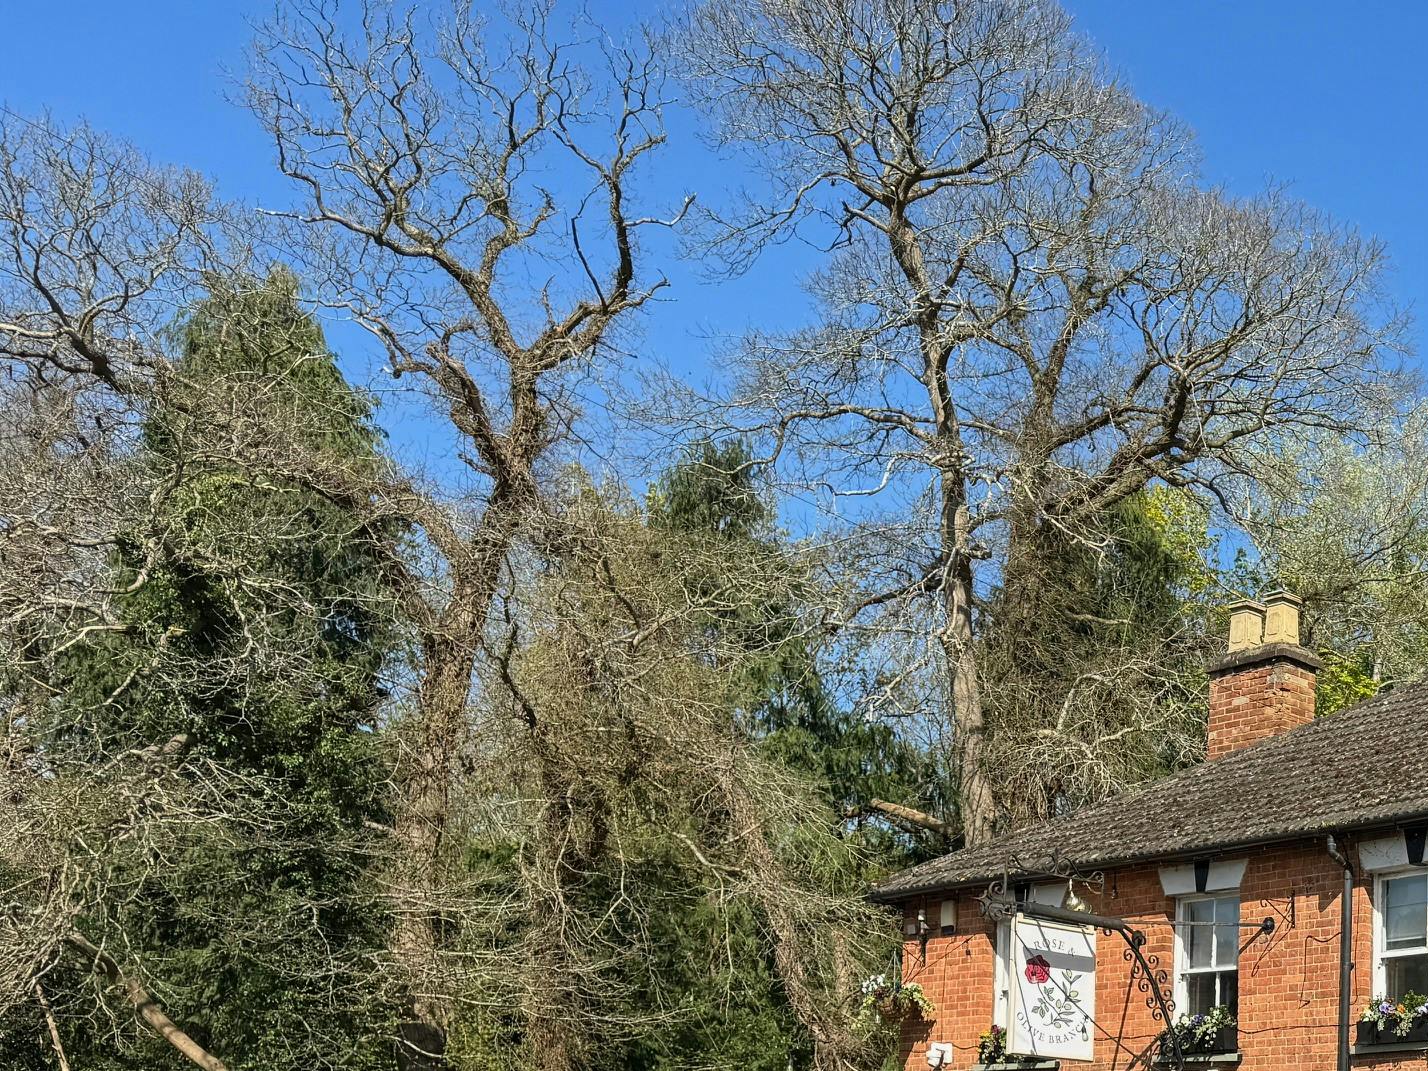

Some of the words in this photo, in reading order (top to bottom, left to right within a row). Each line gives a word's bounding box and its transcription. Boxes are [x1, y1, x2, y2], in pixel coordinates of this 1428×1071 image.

[1033, 938, 1065, 951] ROSE
[1067, 947, 1076, 957] &
[1016, 1011, 1046, 1042] OLIVE
